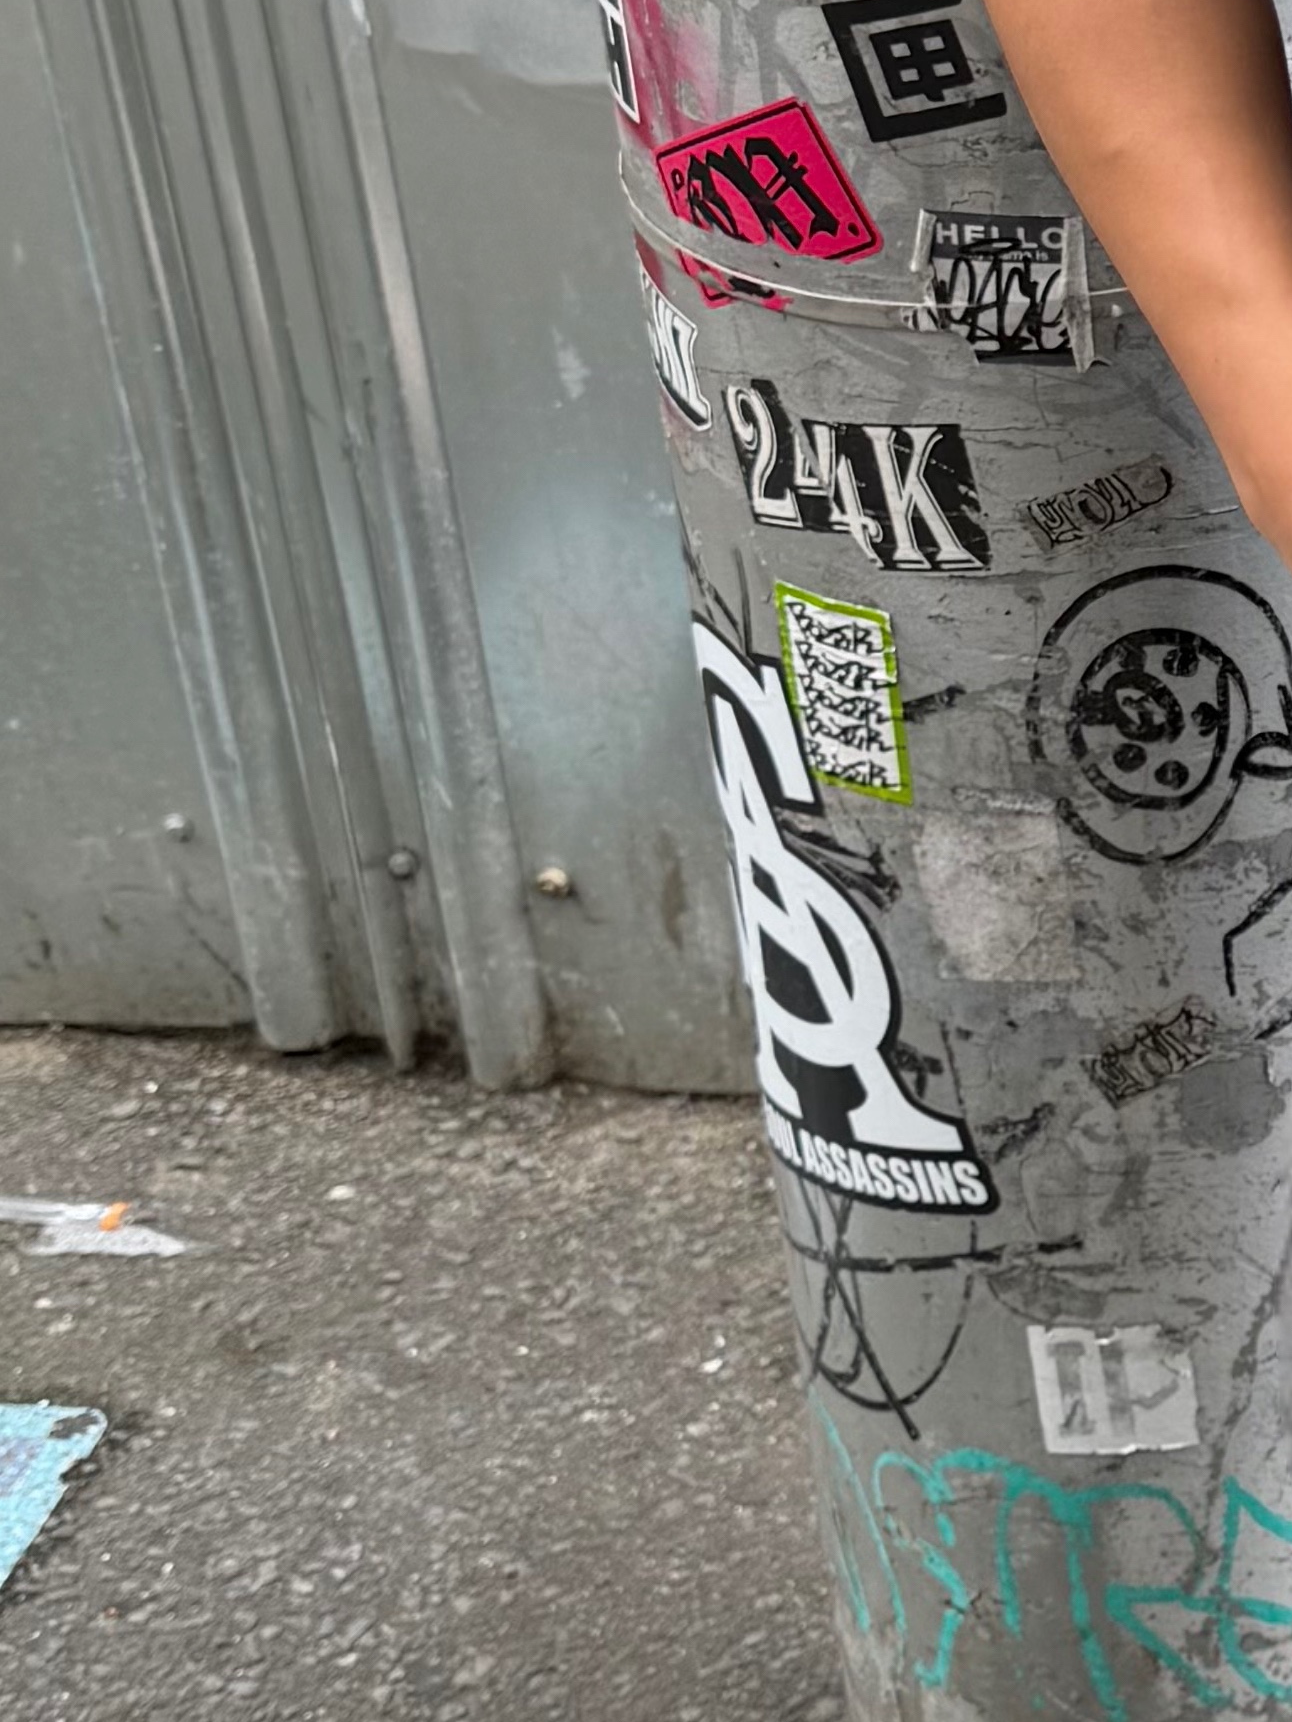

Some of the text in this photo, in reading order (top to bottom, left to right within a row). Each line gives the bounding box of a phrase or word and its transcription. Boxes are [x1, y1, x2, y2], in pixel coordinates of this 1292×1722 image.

[935, 222, 1063, 250] HELLO
[725, 384, 985, 570] 24K
[800, 1127, 989, 1206] ASSASSINS
